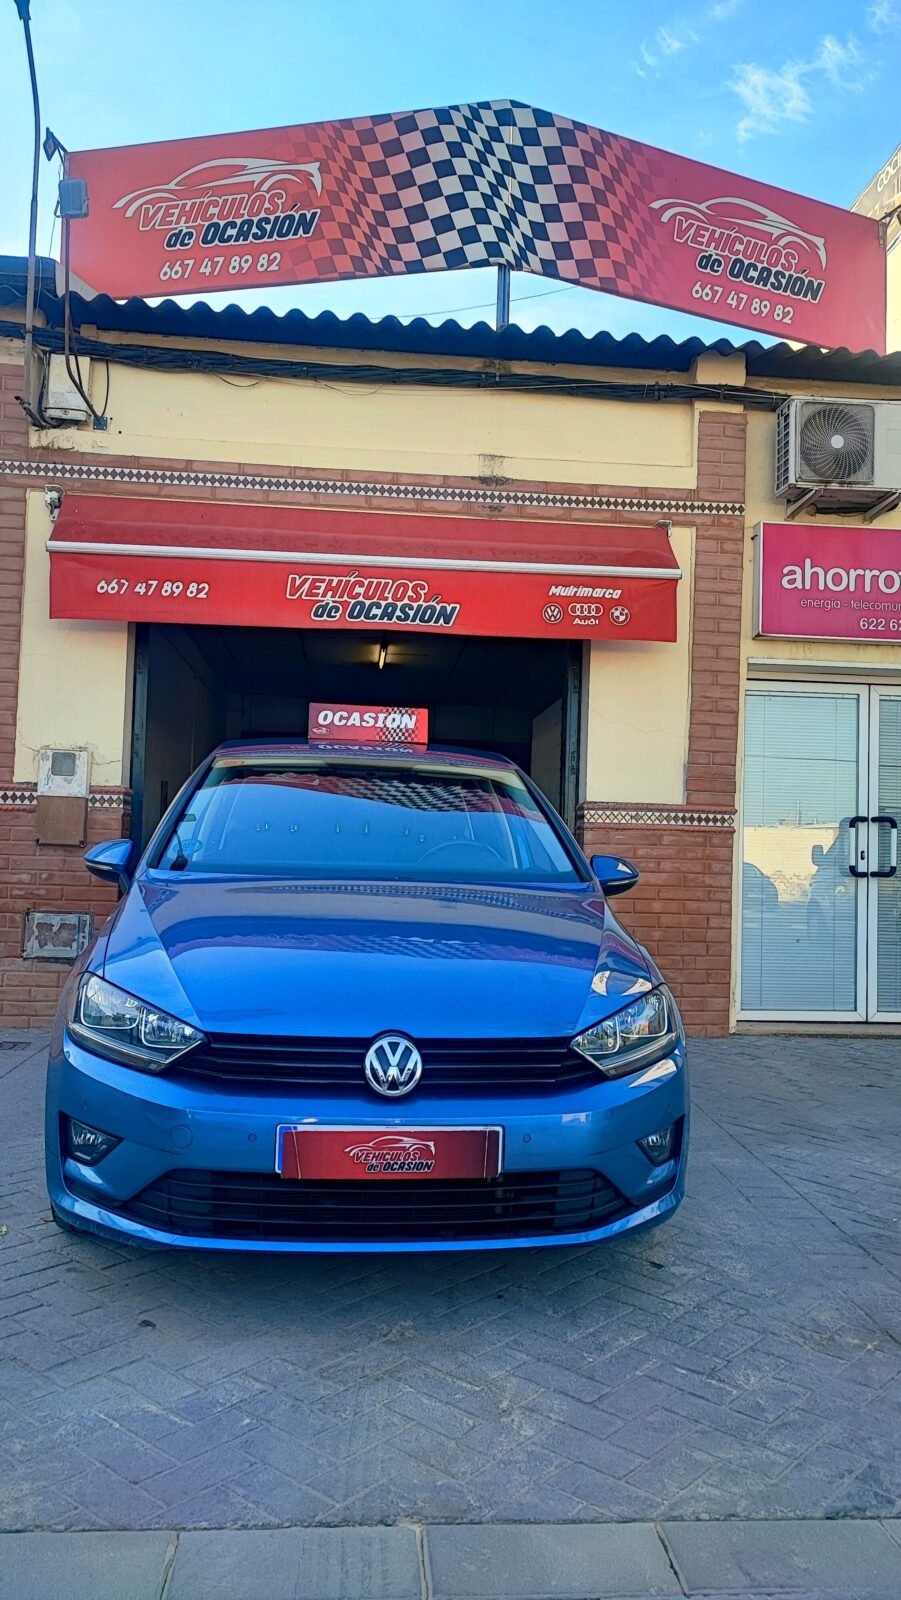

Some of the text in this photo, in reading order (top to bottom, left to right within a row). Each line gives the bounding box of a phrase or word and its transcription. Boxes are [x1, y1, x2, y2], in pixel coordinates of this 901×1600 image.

[139, 190, 286, 231] VEHÍCULOS
[164, 203, 321, 250] de OCASIÓN
[673, 216, 799, 272] VEHÍCULOS
[159, 251, 282, 281] 667 47 89 82
[696, 251, 825, 304] de OCASIÓN
[691, 281, 794, 324] 667 47 89 82
[96, 578, 209, 599] 667 47 89 82
[286, 570, 429, 603] VEHÍCULOS
[781, 558, 901, 594] ahorro
[311, 594, 461, 627] de OCASIÓN
[860, 617, 886, 630] 622
[366, 1160, 380, 1173] de
